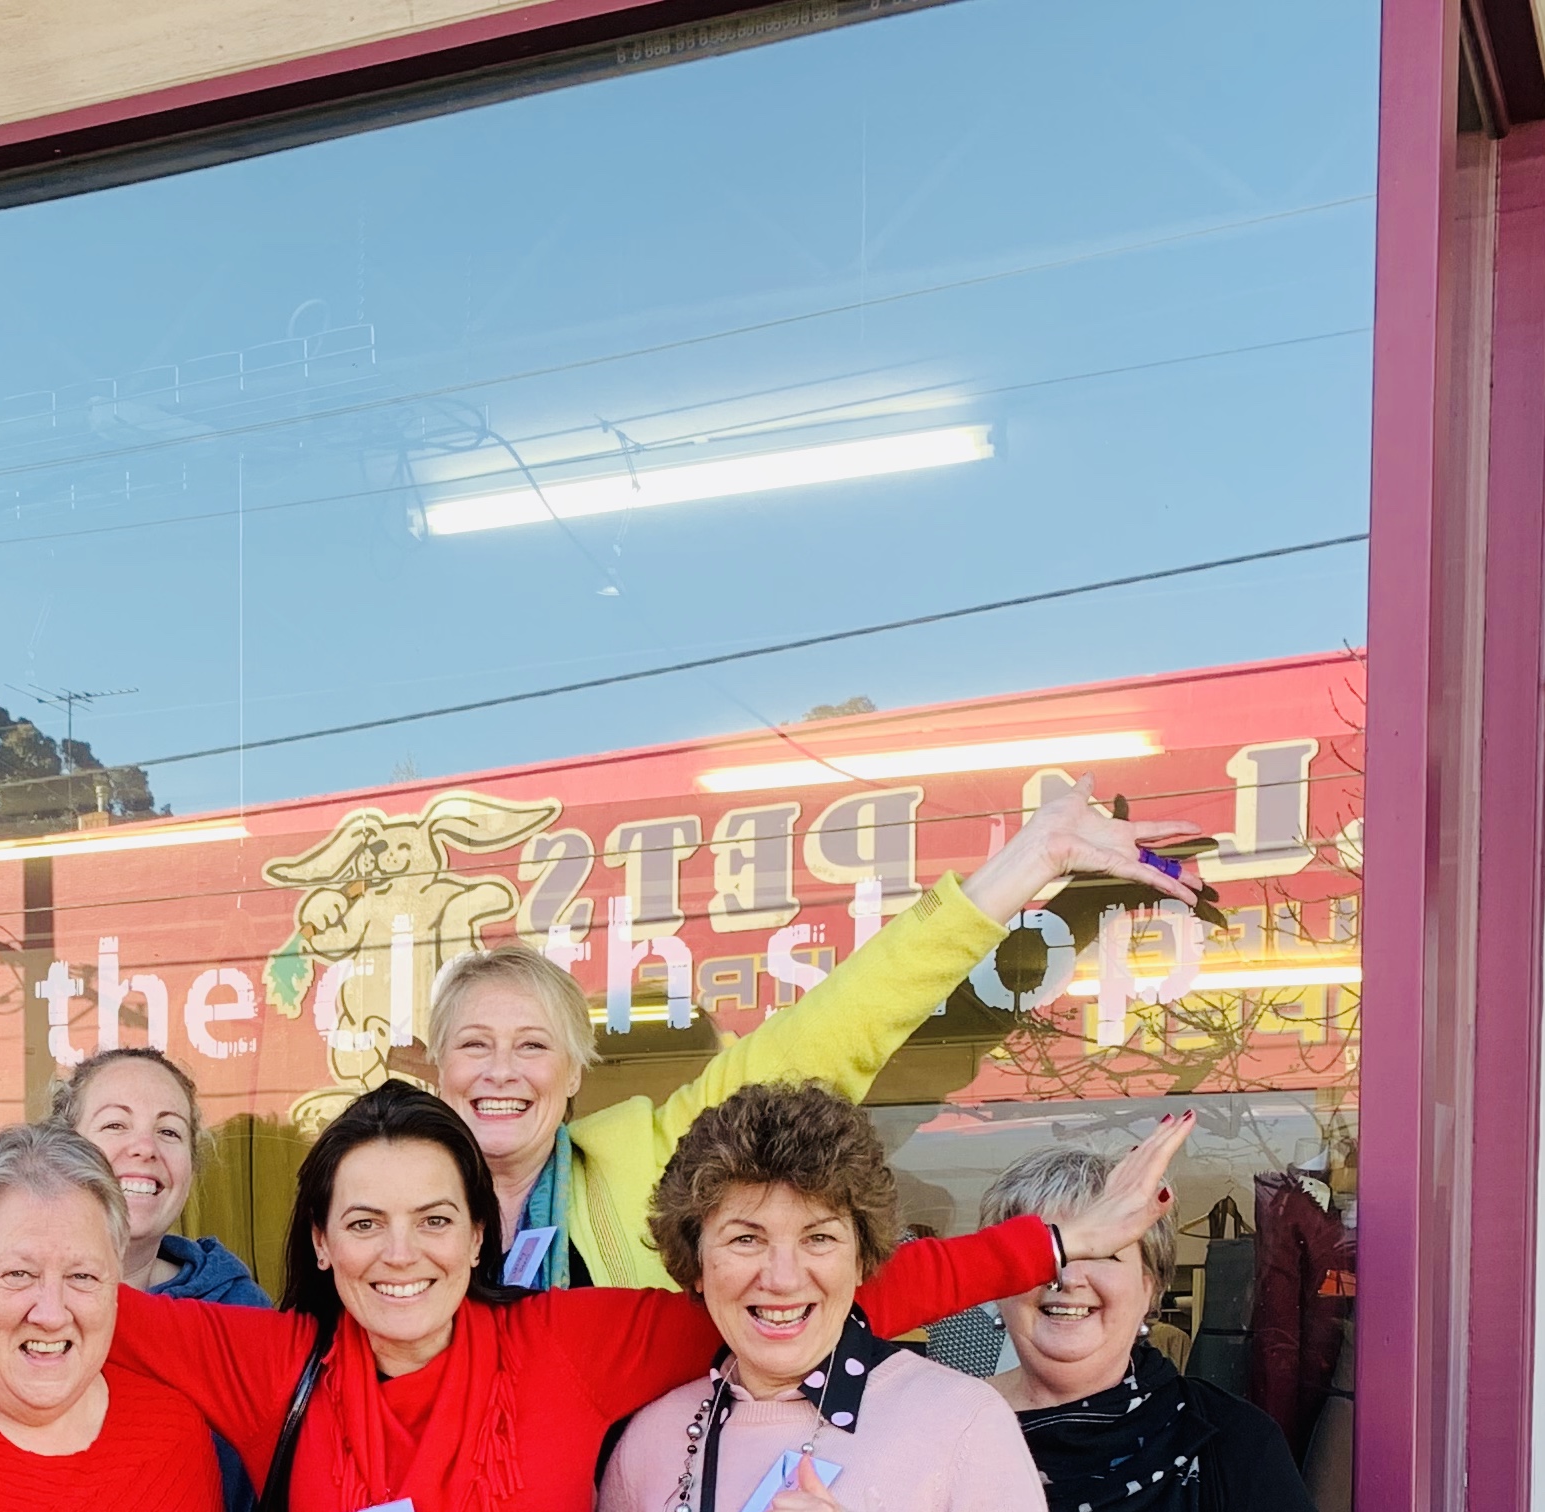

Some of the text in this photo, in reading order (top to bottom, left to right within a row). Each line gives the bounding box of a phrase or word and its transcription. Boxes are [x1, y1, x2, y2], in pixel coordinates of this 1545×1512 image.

[35, 875, 1206, 1067] the clth sop
